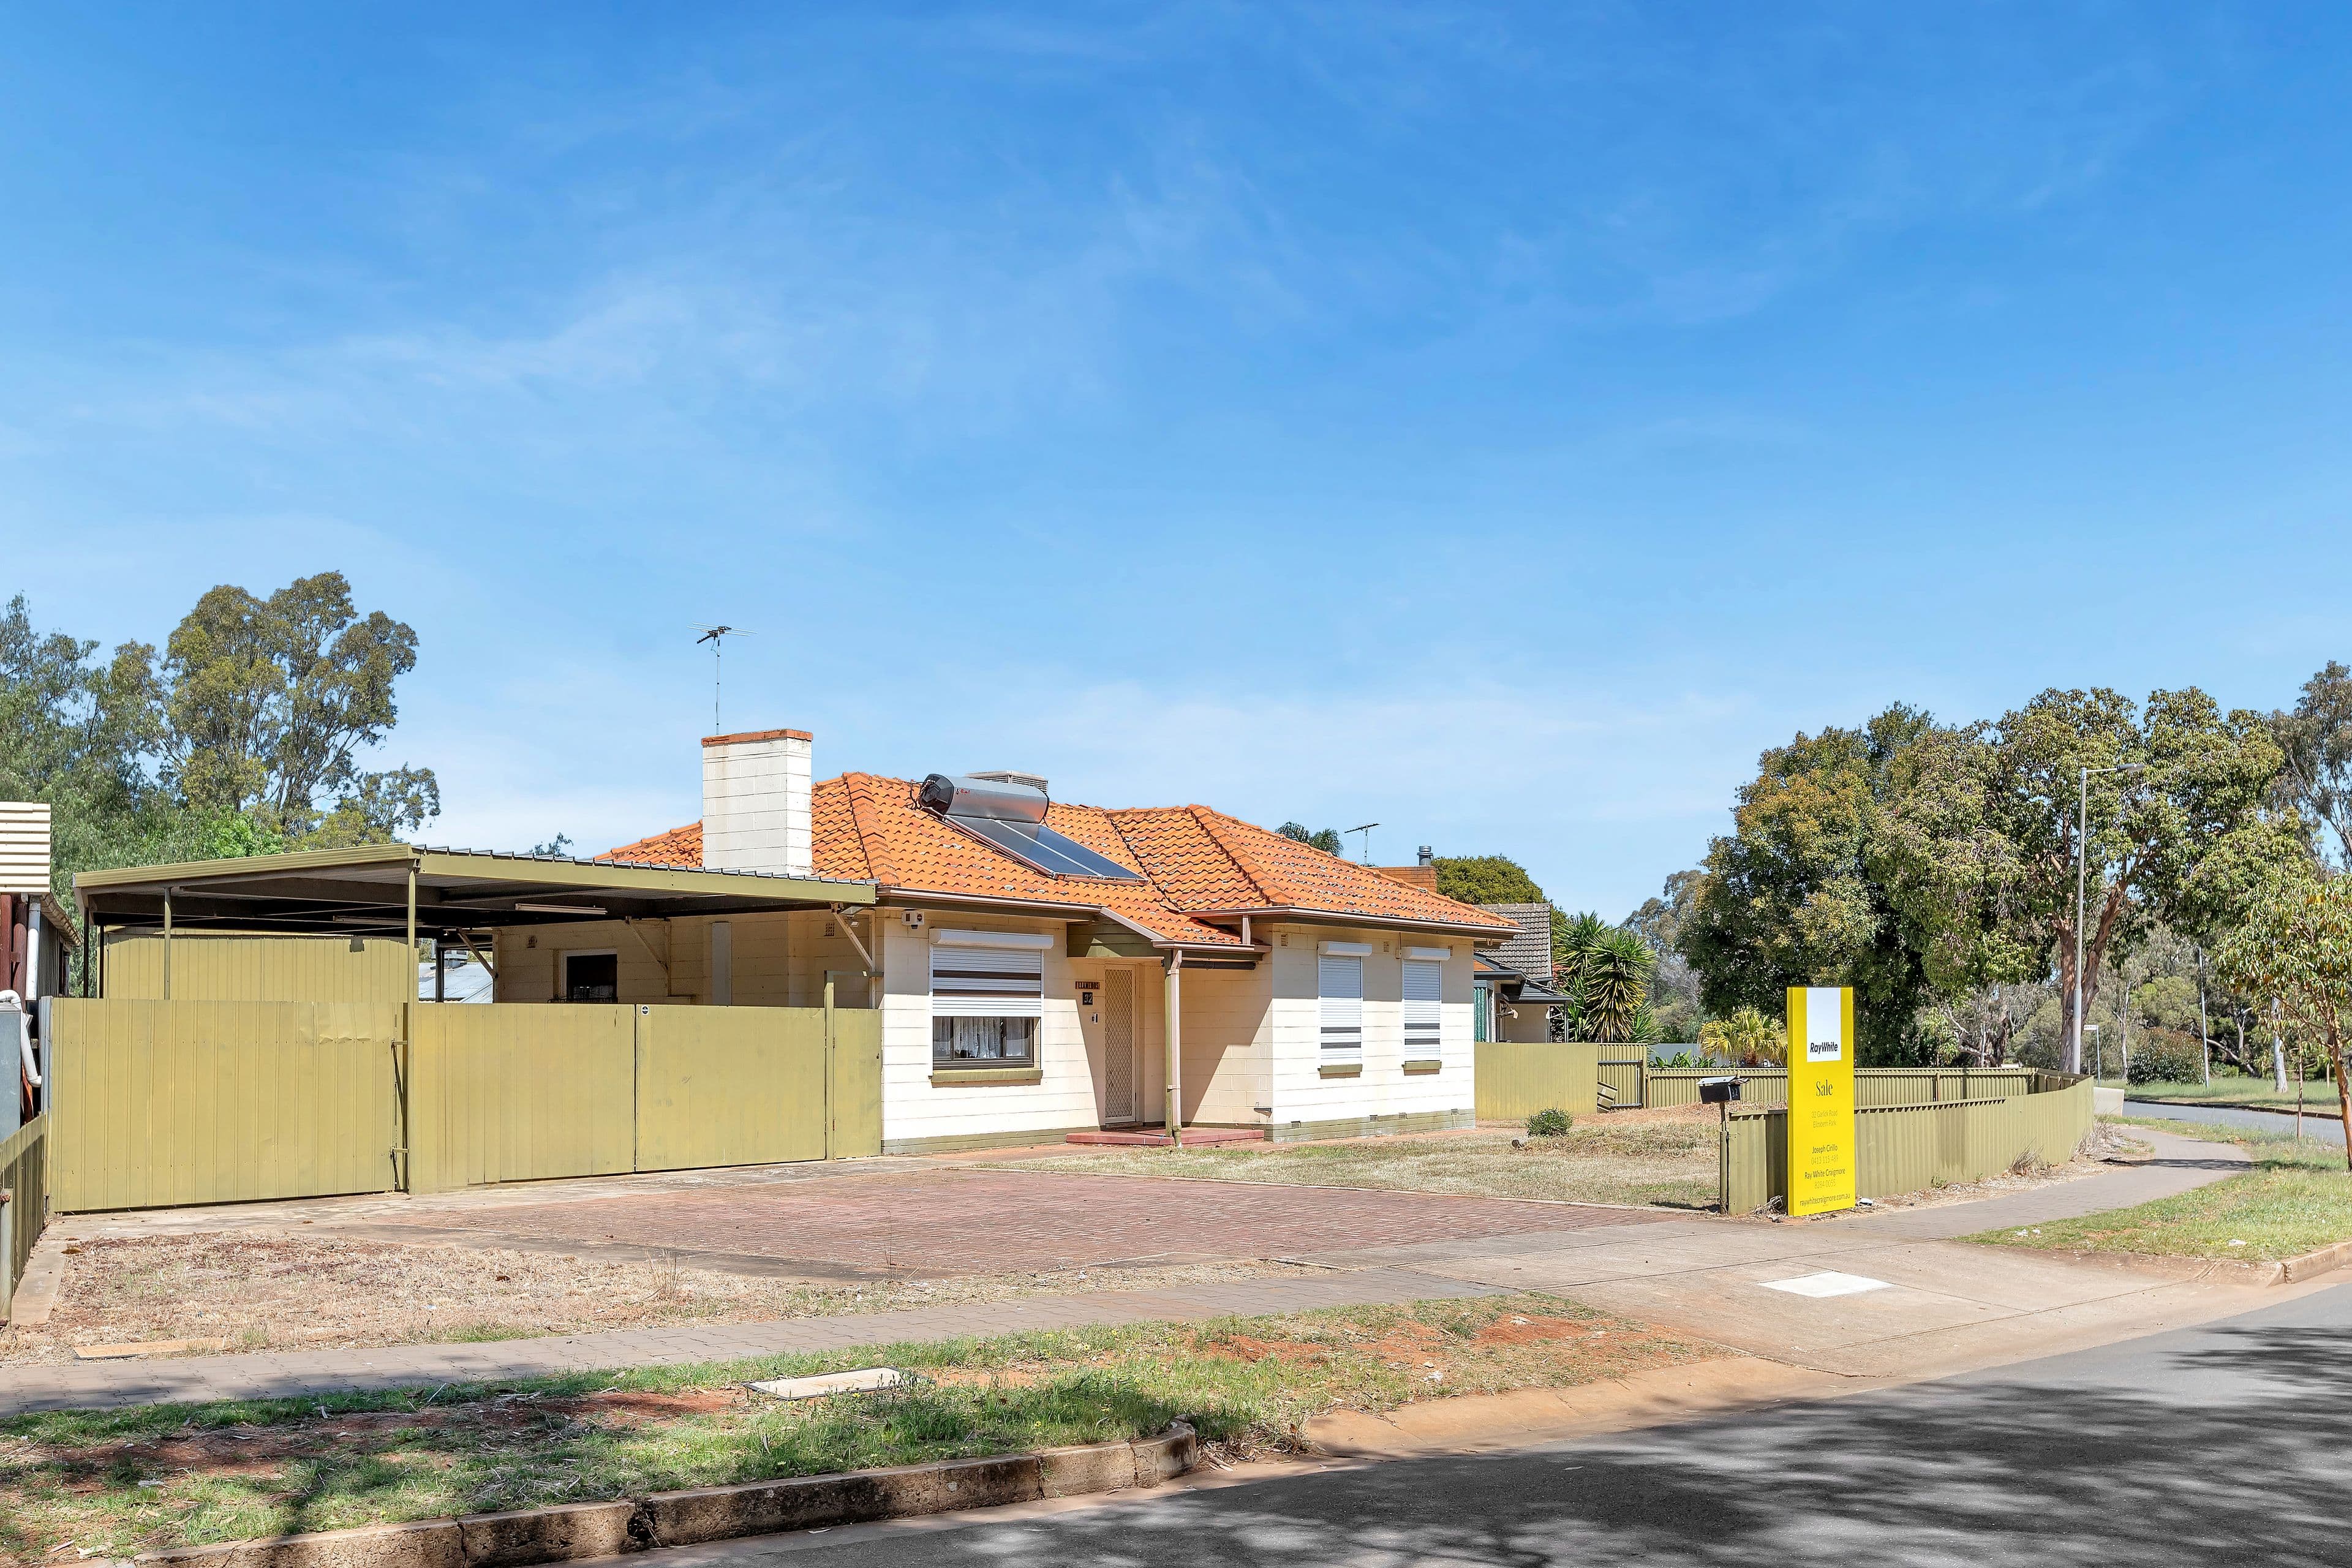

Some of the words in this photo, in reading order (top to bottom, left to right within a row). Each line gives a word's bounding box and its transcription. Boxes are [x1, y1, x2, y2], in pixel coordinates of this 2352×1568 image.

[1084, 994, 1093, 1003] 32
[1816, 1079, 1833, 1096] Sale
[1732, 1088, 1738, 1097] 32
[1812, 1145, 1825, 1154] Joseph
[1826, 1168, 1845, 1177] Craigmore
[1800, 1193, 1850, 1207] raywhitecraigmore.com.au
